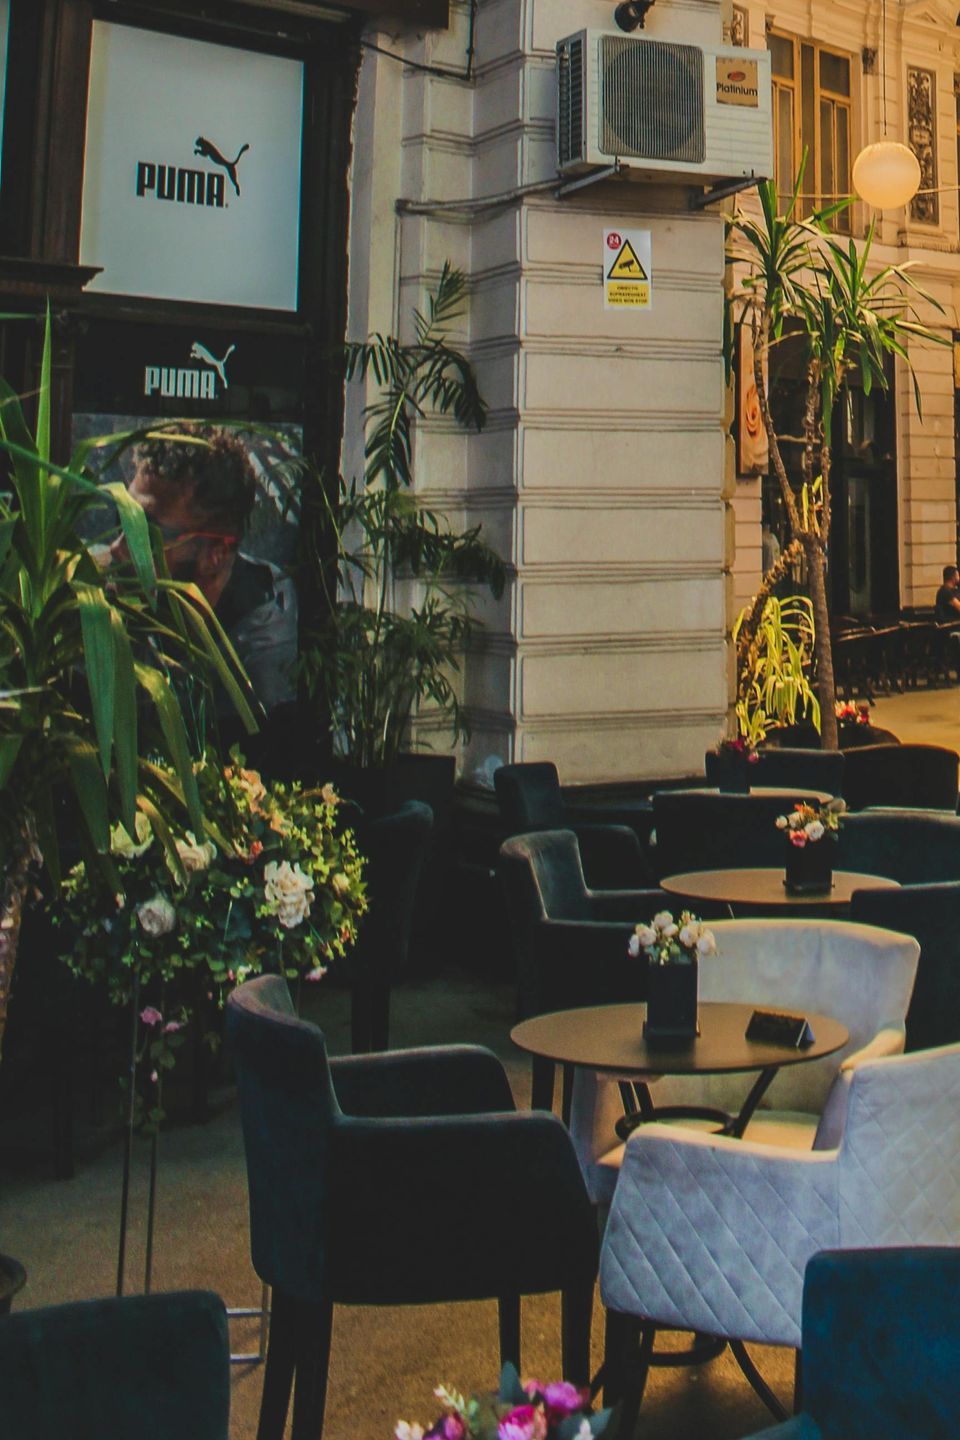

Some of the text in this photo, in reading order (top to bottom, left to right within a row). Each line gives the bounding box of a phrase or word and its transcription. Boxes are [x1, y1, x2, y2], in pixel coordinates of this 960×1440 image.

[716, 82, 758, 96] Platinium
[136, 161, 226, 208] PUMA
[144, 366, 215, 400] PUMA
